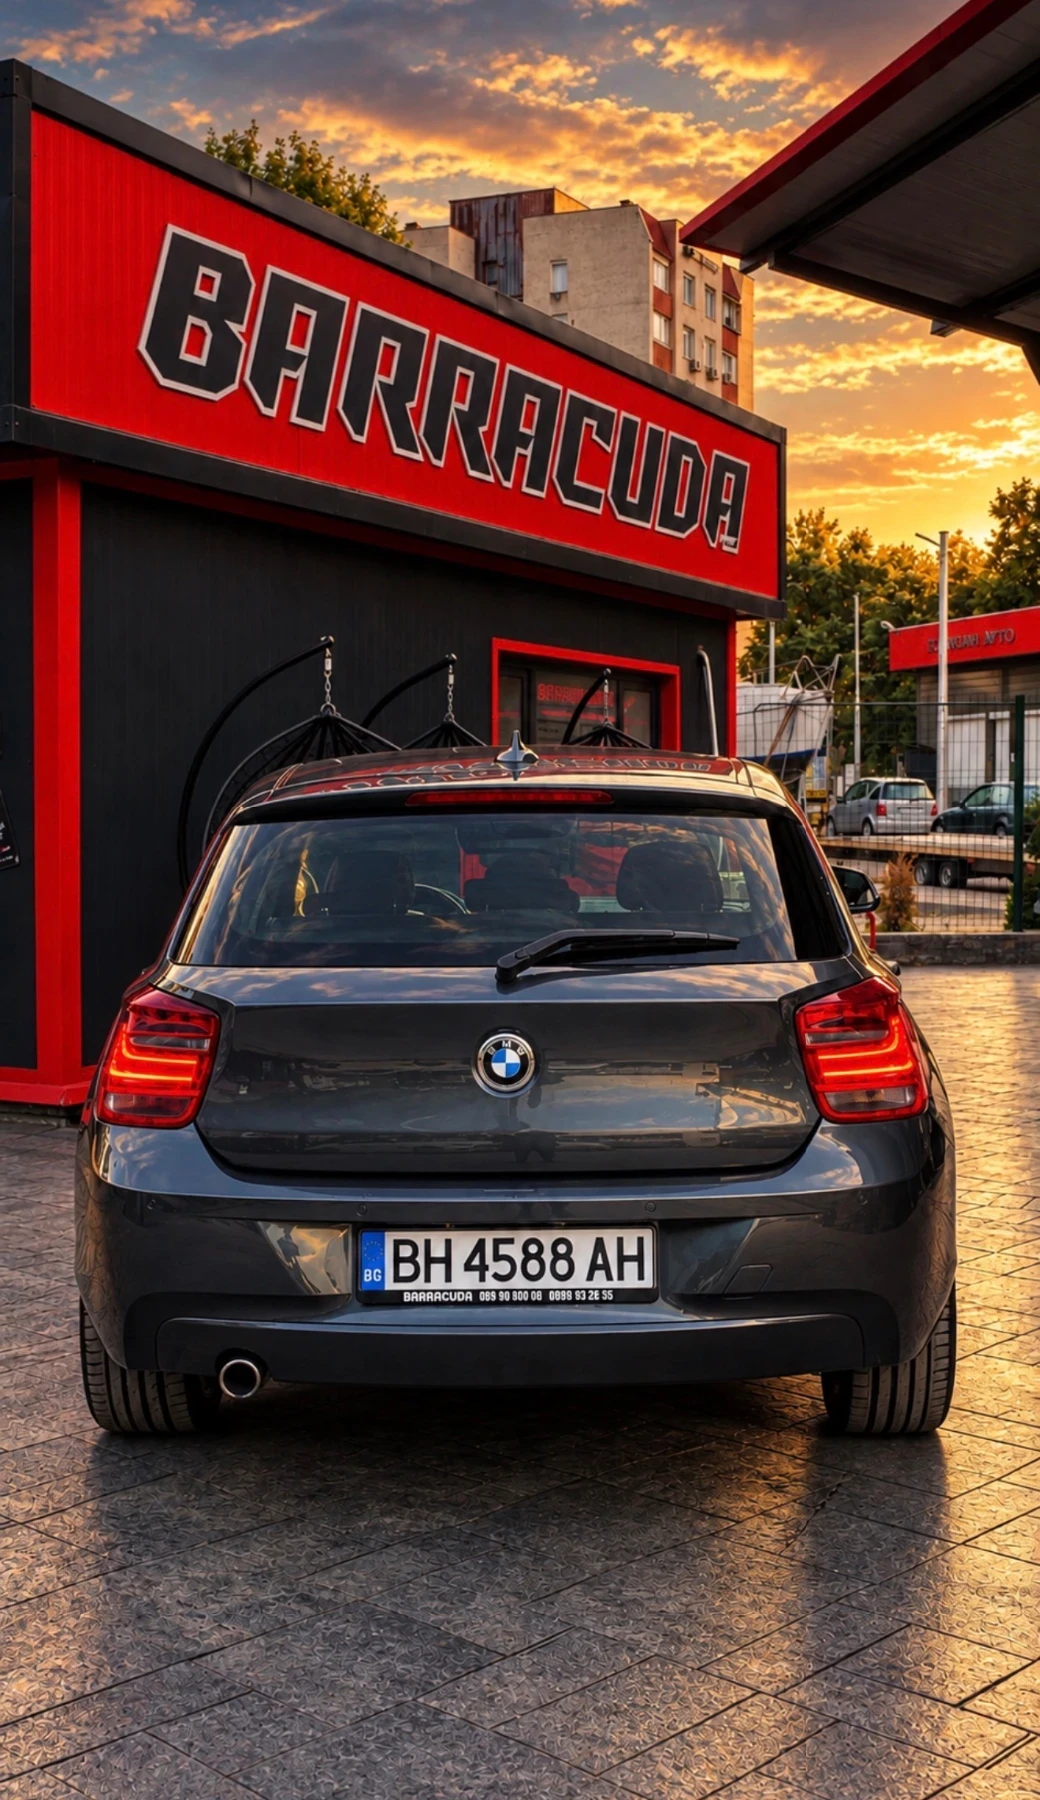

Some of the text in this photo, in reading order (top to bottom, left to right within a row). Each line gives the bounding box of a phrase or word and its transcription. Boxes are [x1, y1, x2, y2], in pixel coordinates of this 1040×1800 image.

[137, 223, 751, 555] BARRACUDA
[363, 1268, 383, 1283] BG
[392, 1235, 645, 1284] BH 4588 AH
[403, 1291, 473, 1302] BARRACUDA
